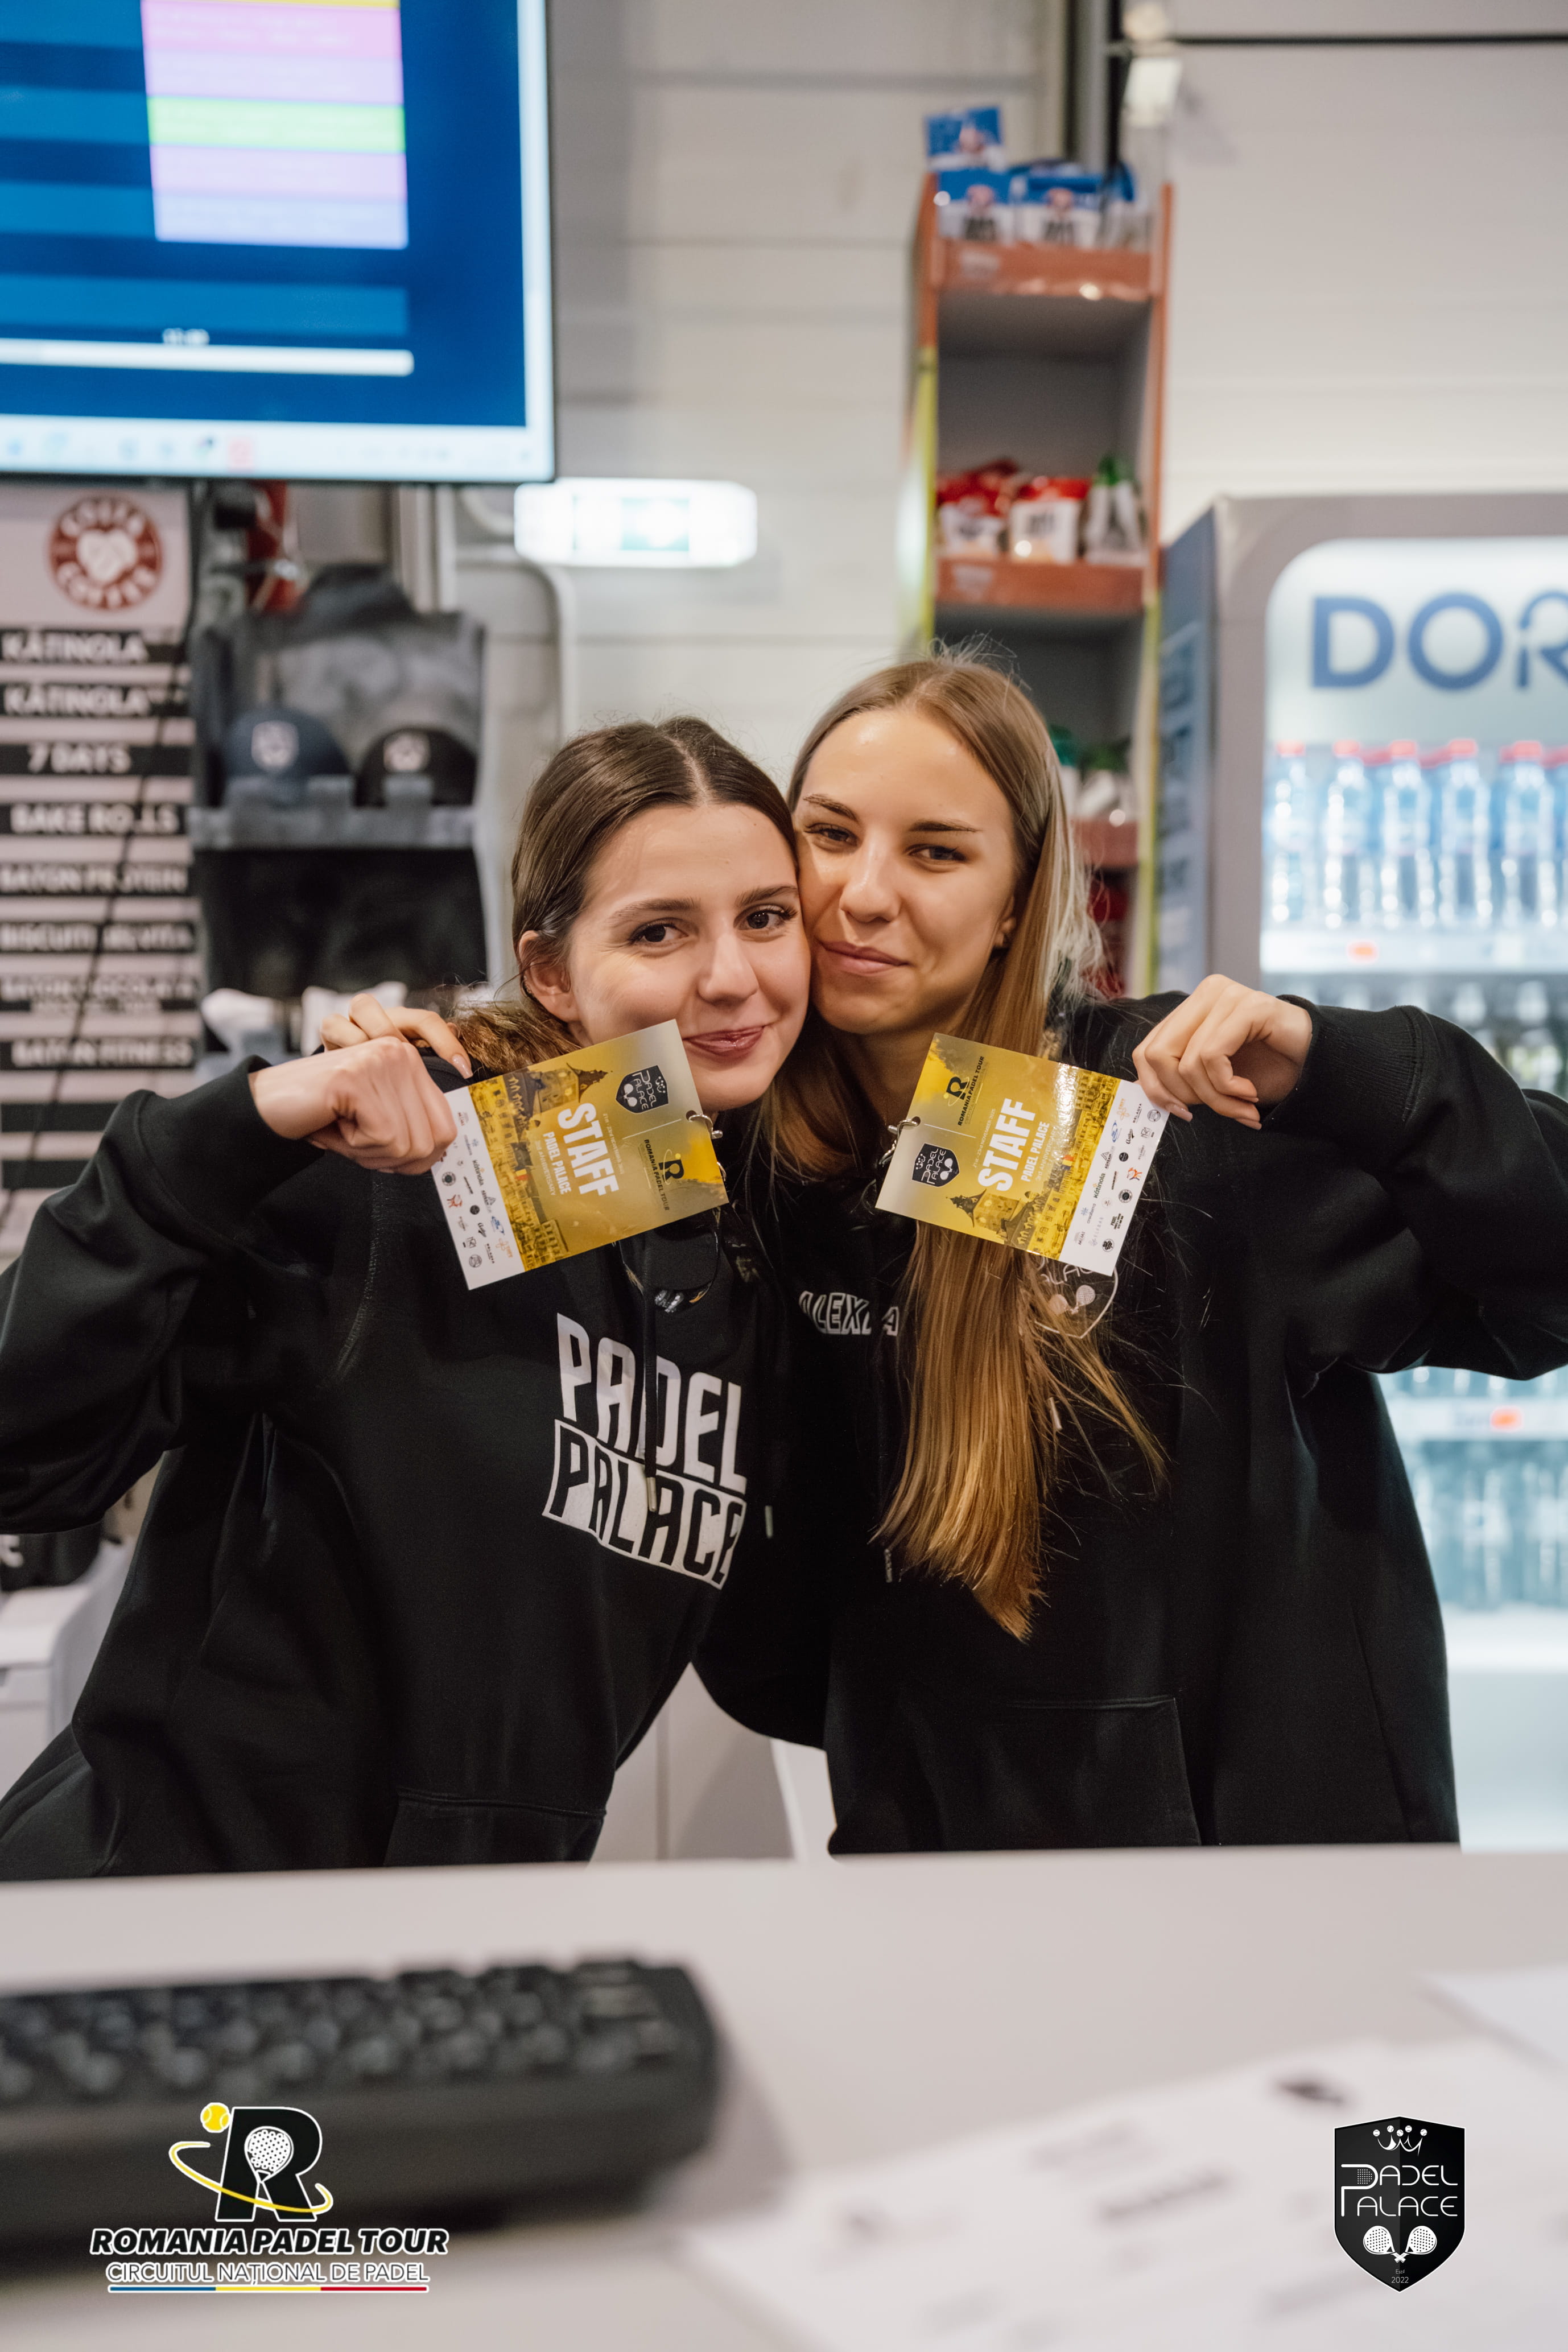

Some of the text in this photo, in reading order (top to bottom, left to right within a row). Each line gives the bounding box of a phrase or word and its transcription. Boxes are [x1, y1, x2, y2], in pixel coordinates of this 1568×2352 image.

[631, 1070, 657, 1107] PADEL
[958, 1095, 971, 1125] ROMANIA
[968, 1074, 978, 1095] PADEL
[975, 1056, 984, 1073] TOUR
[543, 1131, 571, 1194] PADEL PALACE
[557, 1103, 619, 1196] STAFF
[643, 1139, 669, 1211] ROMANIA PADEL TOUR
[921, 1147, 939, 1184] PADEL
[977, 1097, 1037, 1191] STAFF
[1021, 1121, 1050, 1182] PADEL PALACE
[556, 1312, 747, 1496] PADEL
[547, 1424, 744, 1584] PALACE
